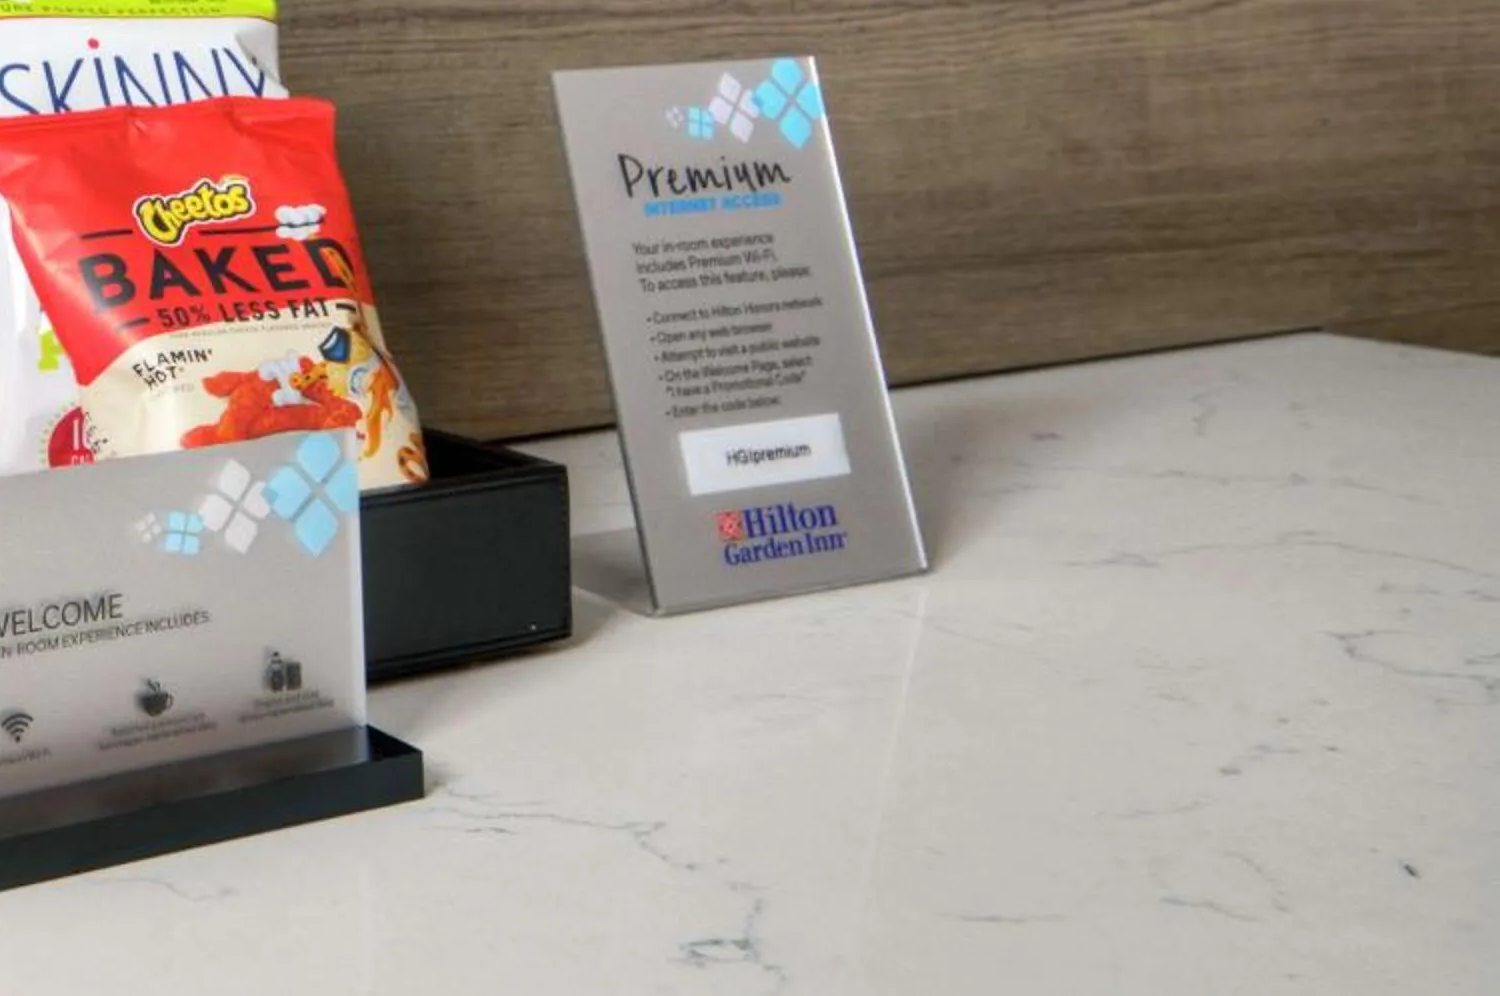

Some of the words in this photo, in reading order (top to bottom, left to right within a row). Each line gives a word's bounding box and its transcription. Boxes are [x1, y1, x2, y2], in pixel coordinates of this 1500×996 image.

[617, 153, 791, 198] Premium
[136, 180, 251, 243] Cheetos
[644, 198, 715, 216] INTERNET
[721, 192, 782, 210] ACCESS
[632, 241, 659, 255] Your
[711, 234, 774, 250] experience
[688, 255, 742, 269] Premium
[79, 238, 355, 312] BAKED
[639, 278, 655, 293] To
[658, 278, 698, 292] access
[699, 274, 722, 287] this
[156, 305, 211, 329] 50%
[218, 302, 280, 323] LESS
[286, 297, 331, 319] FAT
[653, 310, 697, 324] Connect
[657, 332, 686, 345] Open
[132, 349, 213, 377] FLAMIN'
[664, 369, 681, 382] On
[682, 368, 700, 380] the
[144, 365, 179, 390] HOT
[672, 405, 698, 418] Enter
[743, 502, 837, 538] Hilton
[724, 536, 804, 566] Garden
[804, 531, 844, 554] Inn
[62, 622, 146, 648] EXPERIENCE
